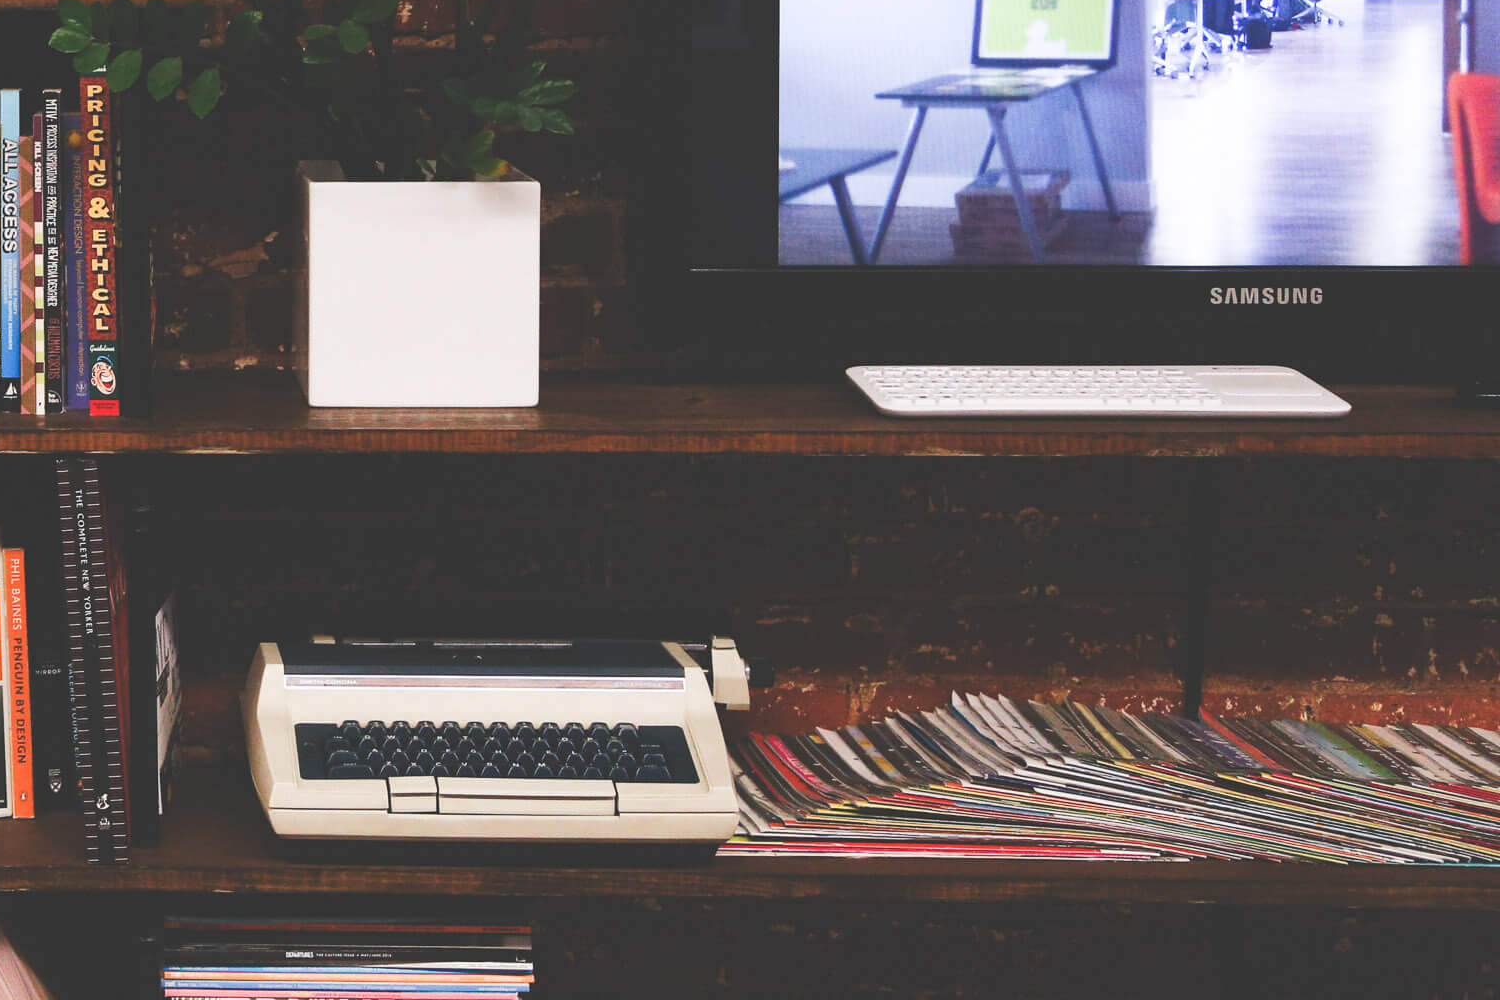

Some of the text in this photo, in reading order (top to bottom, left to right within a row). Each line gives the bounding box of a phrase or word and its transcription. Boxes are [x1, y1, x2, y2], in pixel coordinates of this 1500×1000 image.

[2, 139, 18, 254] ALL ACCESS
[86, 84, 112, 331] PRICING & ETHICAL
[1209, 286, 1324, 306] SAMSUNG
